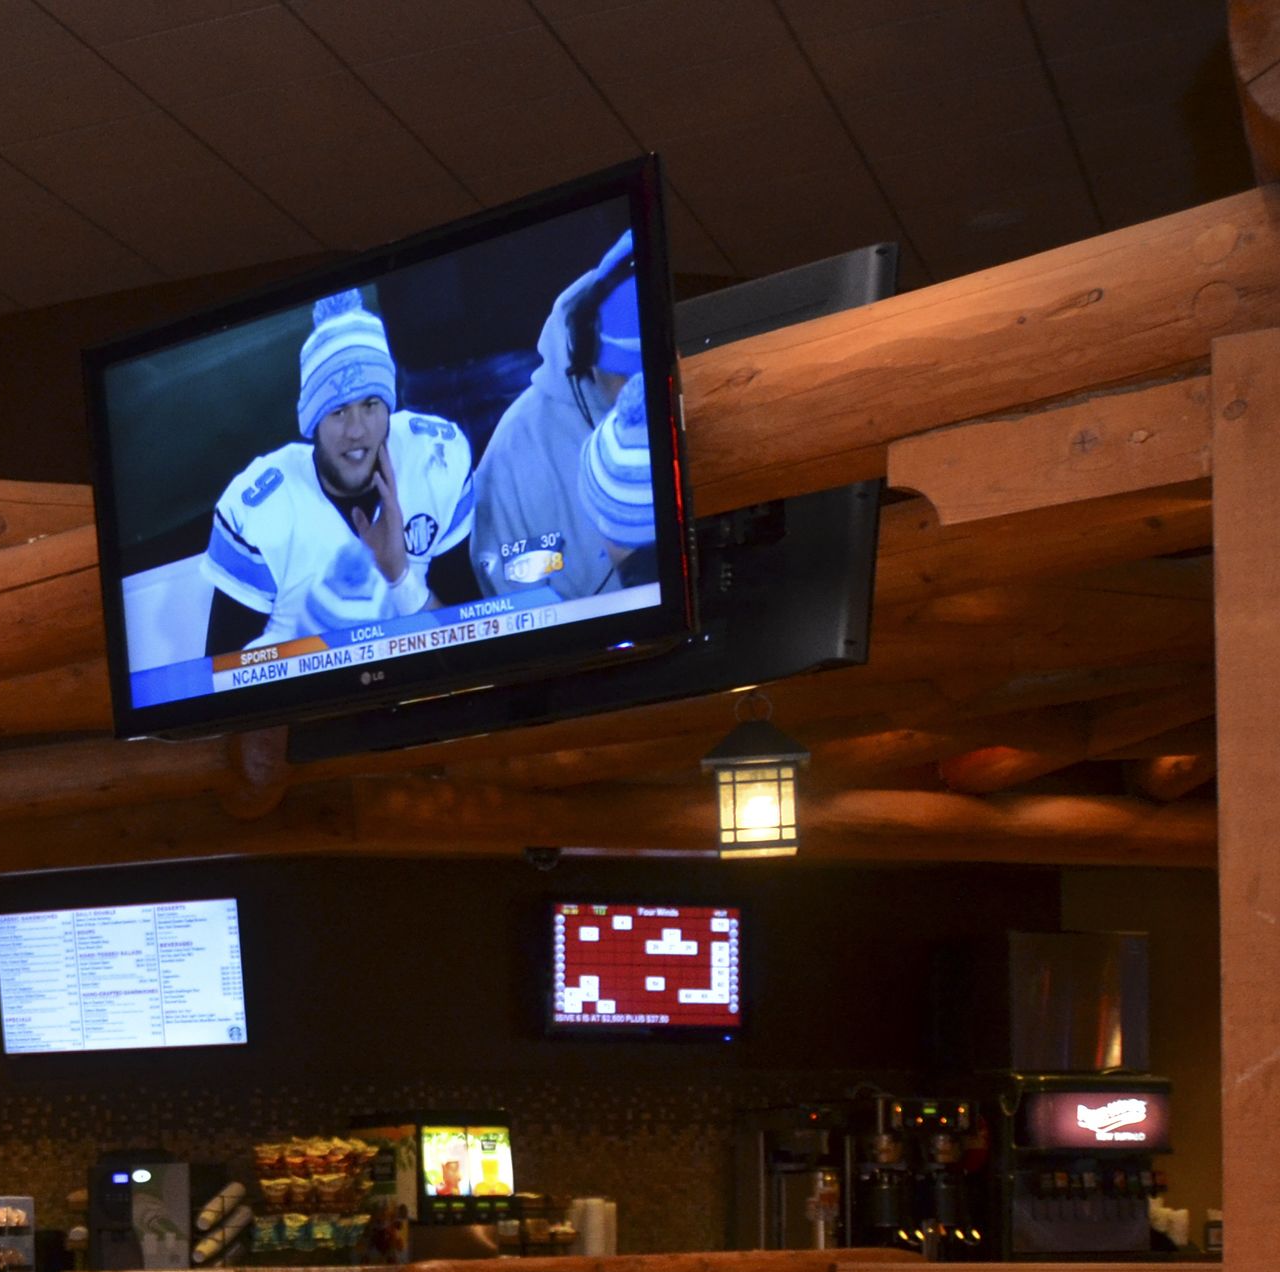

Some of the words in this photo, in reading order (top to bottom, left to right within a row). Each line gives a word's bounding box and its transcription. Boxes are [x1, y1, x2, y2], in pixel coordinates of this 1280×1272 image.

[501, 540, 527, 557] 6:47
[459, 598, 514, 620] NATIONAL
[351, 625, 385, 642] LOCAL
[232, 661, 289, 686] NCAABW
[298, 649, 352, 674] INDIANA
[359, 645, 374, 661] 75
[389, 635, 427, 655] PENN
[430, 626, 476, 646] STATE
[483, 620, 500, 636] 79
[240, 647, 279, 666] SPORTS
